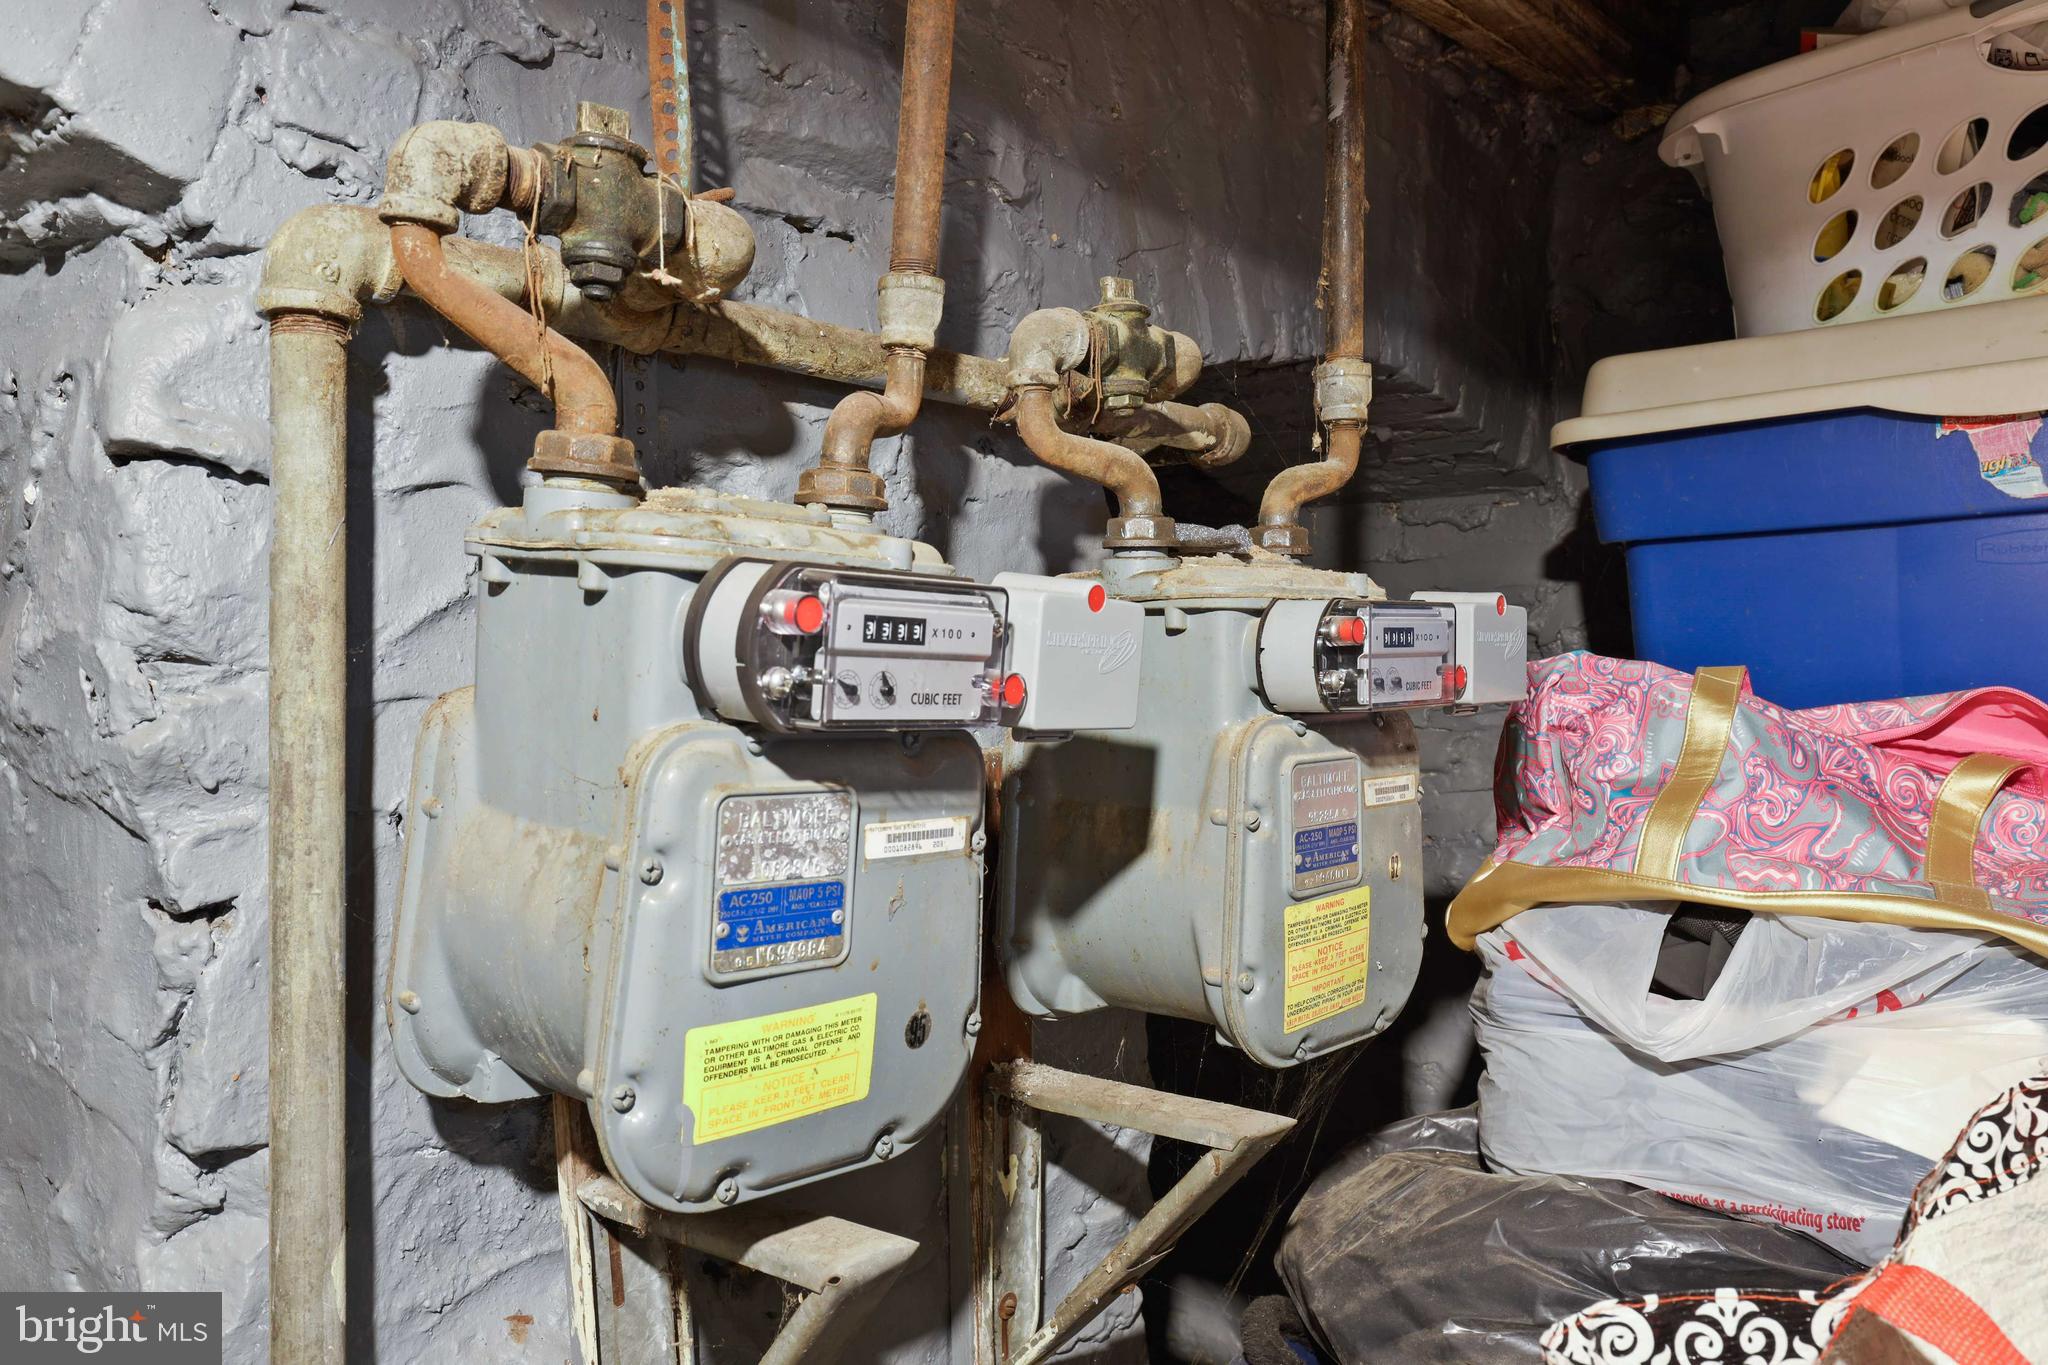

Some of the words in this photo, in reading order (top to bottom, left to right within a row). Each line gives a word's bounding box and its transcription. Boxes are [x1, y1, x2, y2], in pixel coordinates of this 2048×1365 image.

[1405, 681, 1421, 691] CUBIC
[1421, 680, 1433, 690] FEET
[910, 692, 940, 706] CUBIC
[942, 692, 963, 705] FEET
[1299, 830, 1323, 844] AC-250
[1343, 825, 1348, 835] 5
[1348, 823, 1358, 835] PSI
[1313, 849, 1350, 863] AMERICAN
[729, 892, 774, 909] AC-250
[788, 889, 815, 903] MAOP
[817, 888, 824, 898] 5
[825, 885, 841, 898] PSI
[1287, 918, 1311, 929] TAMPERING
[1329, 907, 1349, 919] DAMAGING
[1356, 901, 1368, 910] METER
[1316, 898, 1345, 912] WARNING
[753, 918, 826, 936] AMERICAN
[785, 928, 826, 939] COMPANY
[1287, 931, 1311, 943] EQUIPMENT
[1324, 923, 1342, 932] CRIMINAL
[1344, 917, 1360, 926] OFFENSE
[1295, 924, 1309, 934] OTHER
[1310, 918, 1333, 930] BALTIMORE
[1287, 938, 1311, 949] OFFENDERS
[1317, 941, 1344, 957] NOTICE
[1291, 971, 1310, 982] SPACE
[1320, 962, 1338, 974] FRONT
[1340, 957, 1346, 966] OF
[1348, 952, 1365, 963] METER
[1292, 960, 1312, 973] PLEASE
[1313, 955, 1329, 967] KEEP
[1335, 948, 1350, 959] FEET
[1349, 943, 1365, 954] CLEAR
[1312, 975, 1345, 993] IMPORTANT
[1286, 1000, 1321, 1018] UNDERGROUND
[1321, 994, 1337, 1005] PIPING
[1342, 987, 1353, 997] YOUR
[1287, 1003, 1294, 1012] TO
[1294, 999, 1306, 1008] HELP
[1306, 993, 1327, 1004] CONTROL
[1327, 983, 1351, 997] CORROSION
[761, 1014, 816, 1034] WARNING
[705, 1042, 749, 1055] TAMPERING
[751, 1037, 770, 1046] WITH
[773, 1034, 783, 1042] OR
[785, 1026, 822, 1040] DAMAGING
[824, 1021, 839, 1030] THIS
[840, 1015, 862, 1027] METER
[703, 1059, 748, 1074] EQUIPMENT
[753, 1056, 761, 1064] IS
[766, 1053, 772, 1061] A
[776, 1046, 808, 1059] CRIMINAL
[814, 1036, 843, 1049] OFFENSE
[847, 1032, 861, 1041] AND
[704, 1056, 716, 1065] OR
[719, 1051, 745, 1062] OTHER
[747, 1041, 790, 1056] BALTIMORE
[792, 1037, 807, 1046] GAS
[817, 1027, 848, 1041] ELECTRIC
[703, 1067, 749, 1082] OFFENDERS
[750, 1063, 767, 1072] WILL
[770, 1060, 780, 1068] BE
[762, 1072, 806, 1092] NOTICE
[708, 1102, 748, 1117] PLEASE
[752, 1093, 779, 1107] KEEP
[794, 1083, 816, 1096] FEET
[821, 1073, 850, 1089] CLEAR
[708, 1114, 743, 1129] SPACE
[748, 1108, 759, 1118] IN
[763, 1100, 796, 1115] FRONT
[801, 1095, 815, 1107] OF
[818, 1086, 849, 1102] METER
[1741, 1203, 1823, 1232] participating
